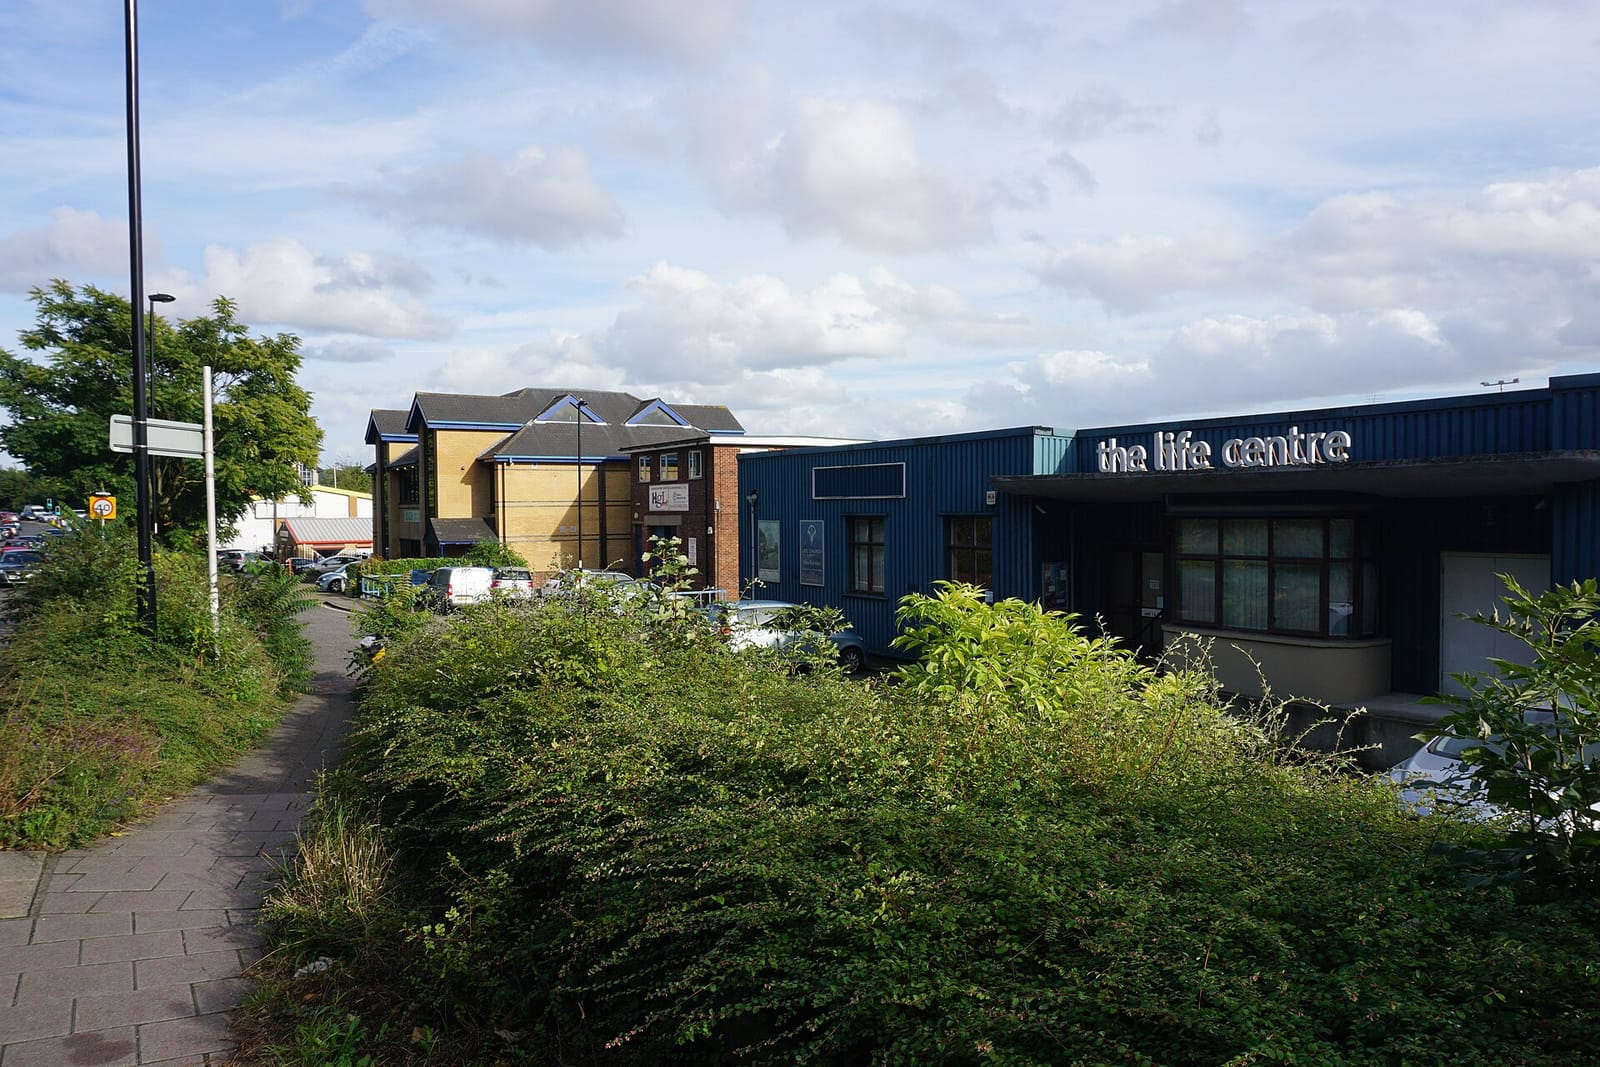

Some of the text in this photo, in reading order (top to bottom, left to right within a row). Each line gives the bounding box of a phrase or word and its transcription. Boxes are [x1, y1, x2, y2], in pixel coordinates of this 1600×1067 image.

[1096, 426, 1351, 472] the life centre
[95, 504, 110, 512] 40
